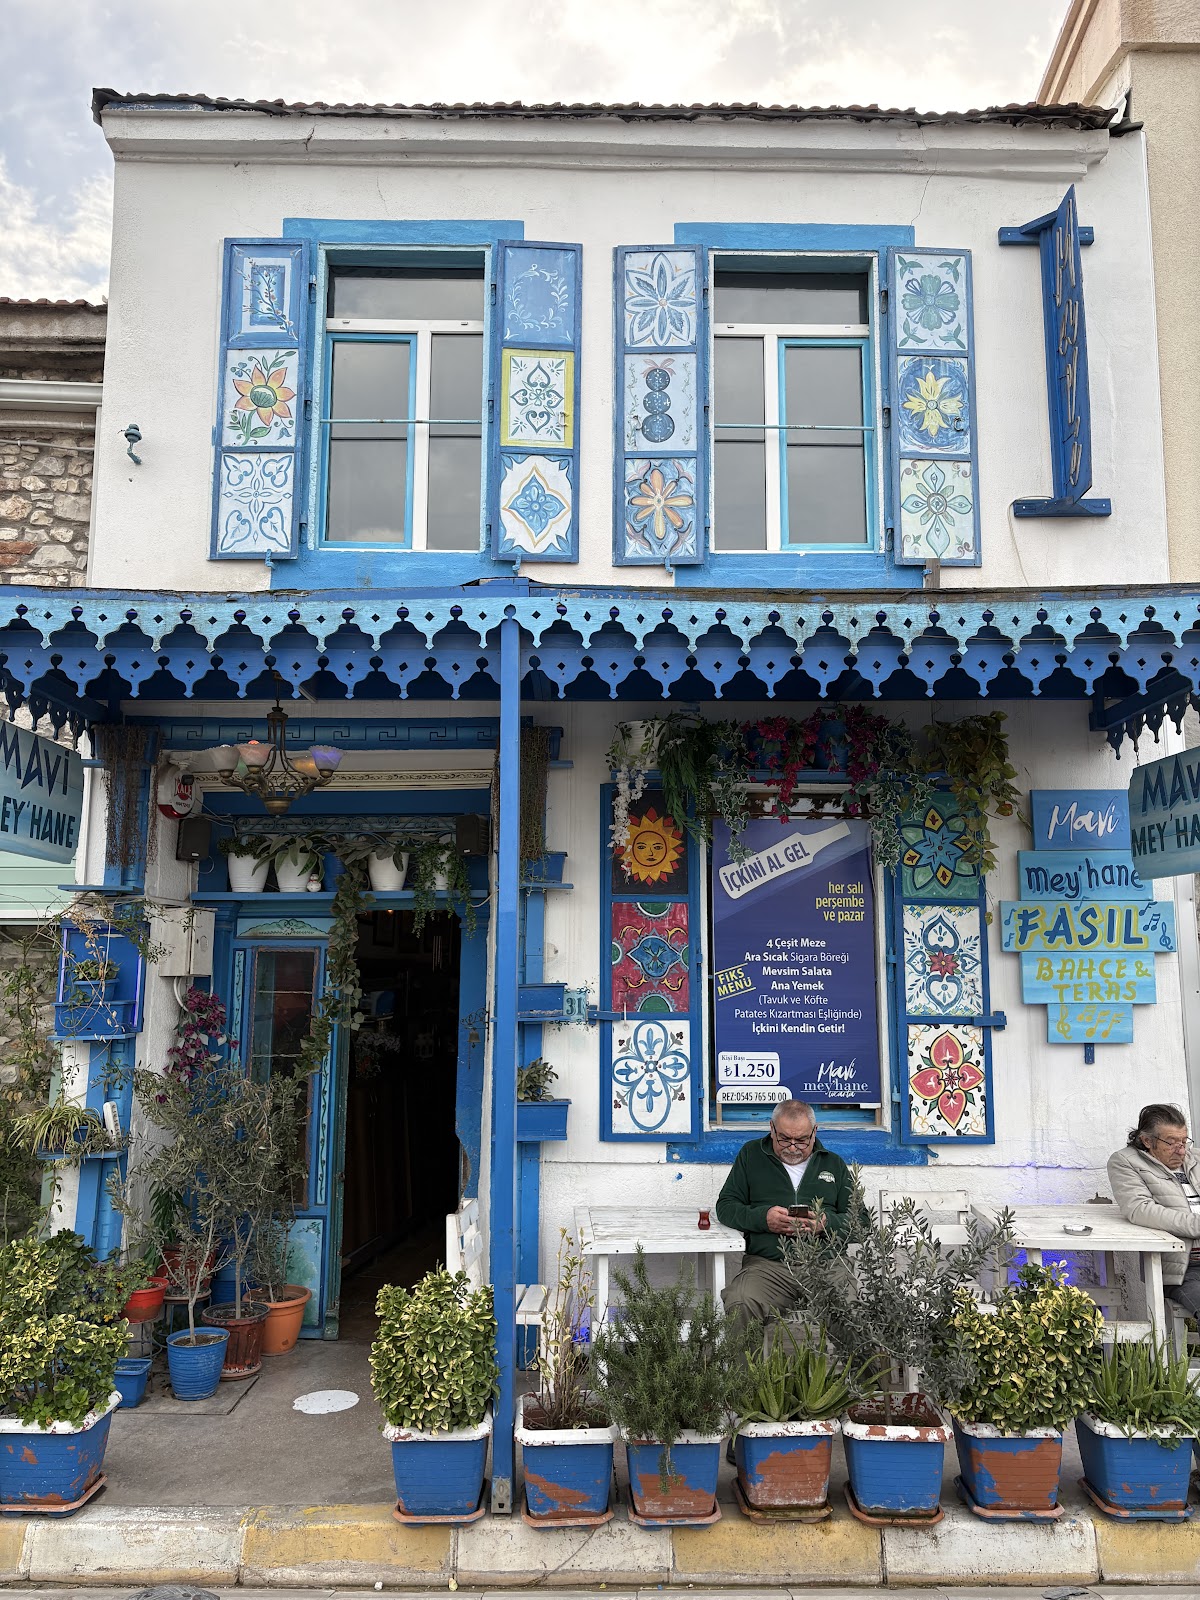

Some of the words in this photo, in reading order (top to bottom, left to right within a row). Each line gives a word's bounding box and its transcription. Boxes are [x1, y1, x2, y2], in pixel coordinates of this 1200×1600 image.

[1142, 754, 1200, 814] MAV
[0, 795, 76, 850] EY'HANE
[1047, 796, 1119, 842] Mavi
[1131, 813, 1200, 858] MEY'HA
[722, 857, 766, 892] İÇKİNİ
[768, 852, 785, 873] AL
[784, 841, 811, 863] GEL
[1025, 858, 1144, 898] mey'hane
[828, 882, 844, 894] her
[847, 882, 864, 894] salı
[815, 896, 865, 910] perşembe
[823, 912, 836, 922] ve
[838, 911, 865, 924] pazar
[1016, 905, 1147, 949] FASIL
[766, 939, 774, 948] 4
[775, 938, 799, 949] Çeşit
[800, 938, 826, 948] Meze
[744, 952, 761, 962] Ara
[763, 952, 789, 962] Sıcak
[790, 952, 818, 964] Sigara
[820, 952, 849, 964] Böreği
[762, 967, 800, 976] Mevsim
[801, 967, 832, 976] Salata
[1134, 960, 1152, 978] &
[717, 976, 752, 996] MENÜ
[771, 981, 790, 991] Ana
[791, 981, 825, 991] Yemek
[1052, 979, 1137, 1003] TERAS
[758, 994, 789, 1005] (Tavuk
[790, 997, 801, 1005] ve
[804, 994, 828, 1005] Köfte
[734, 1009, 767, 1019] Patates
[769, 1009, 816, 1019] Kızartması
[818, 1008, 862, 1021] Eşliğinde)
[752, 1022, 779, 1035] İçkini
[781, 1023, 816, 1033] Kendin
[817, 1023, 845, 1033] Getir!
[817, 1057, 857, 1083] Mavi
[803, 1078, 869, 1095] mey'hane
[722, 1091, 753, 1102] REZ:0545
[754, 1091, 767, 1102] 765
[767, 1091, 777, 1102] 50
[777, 1091, 787, 1102] 00
